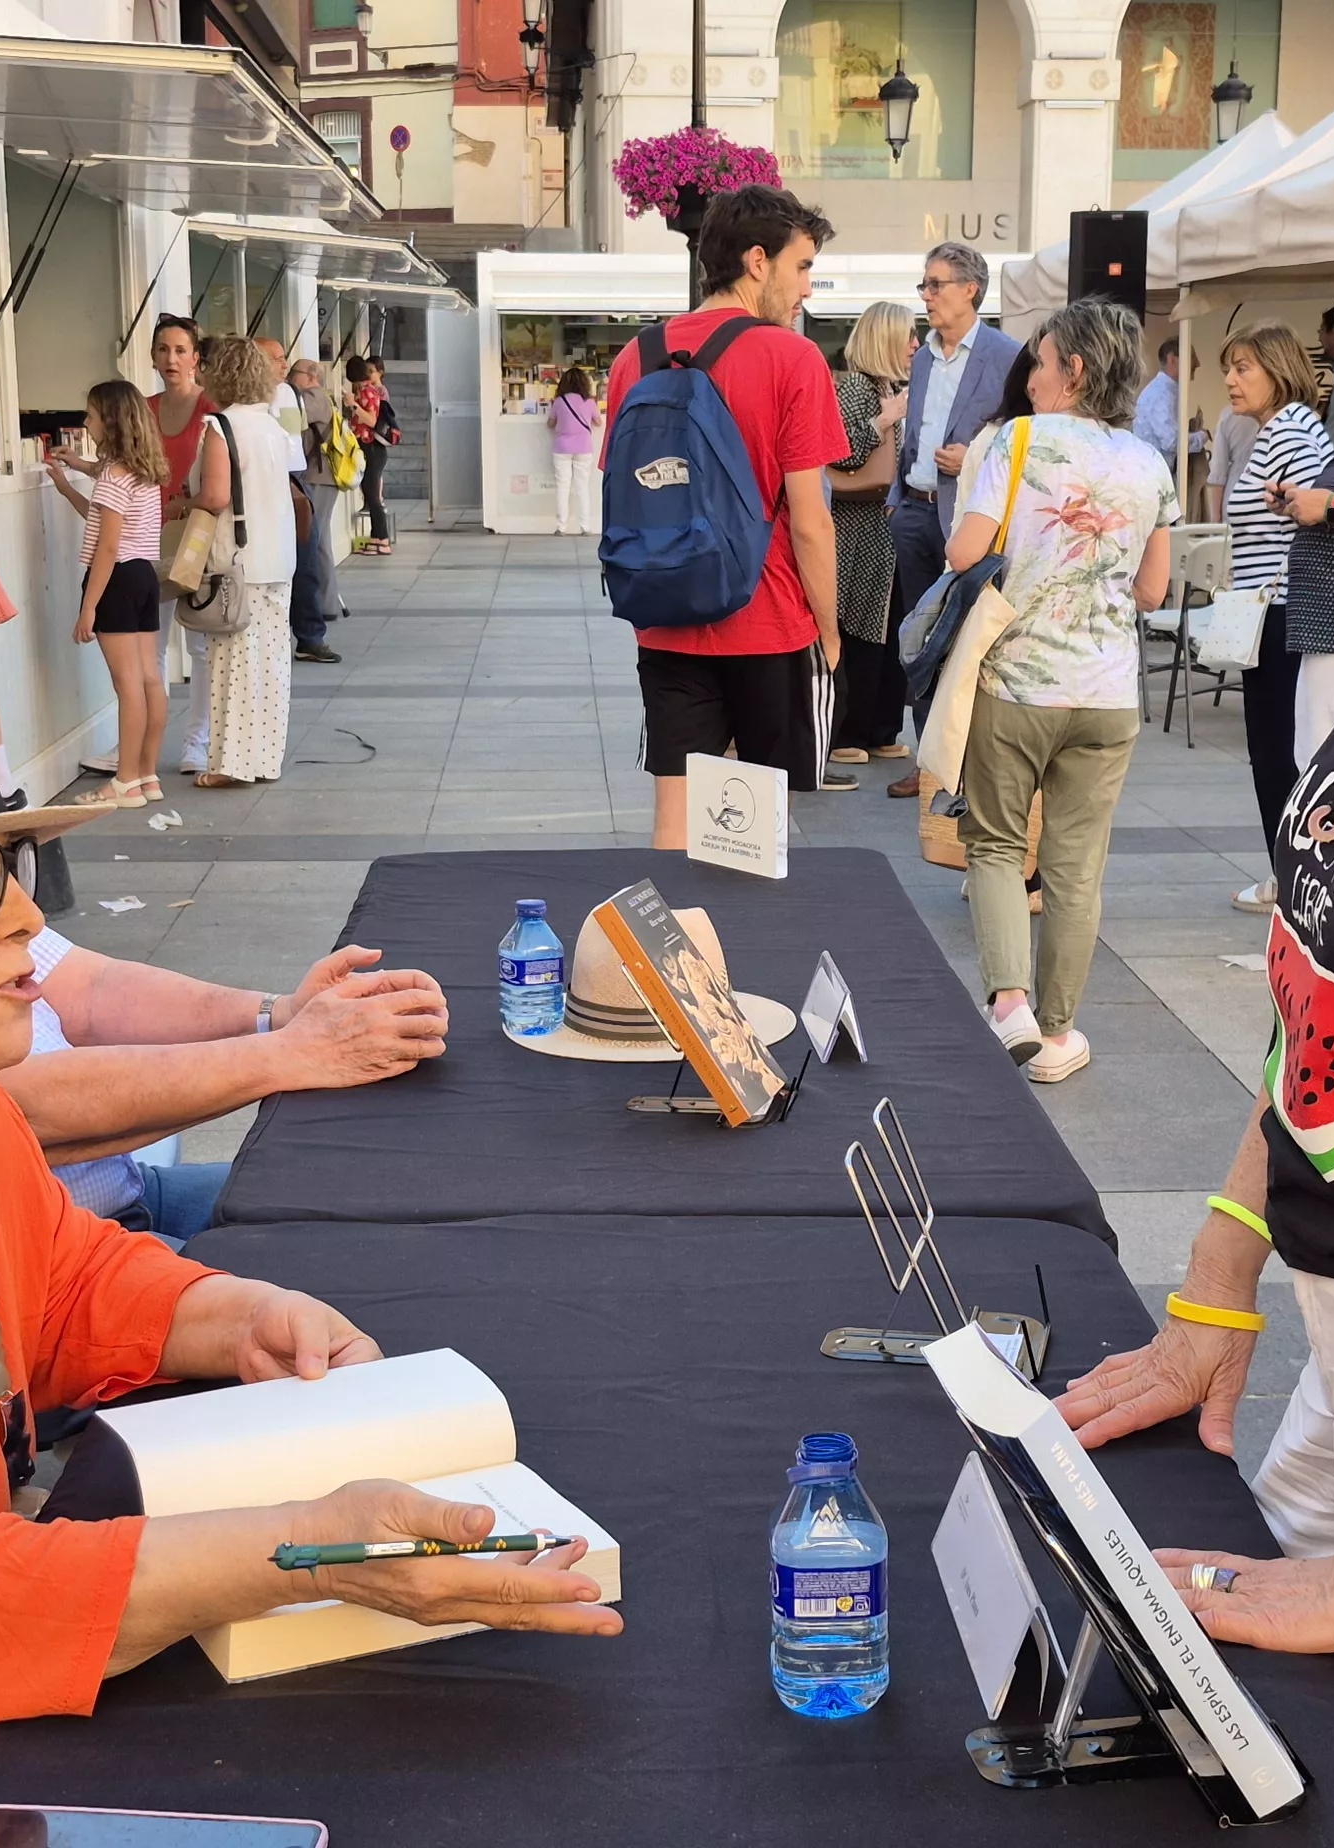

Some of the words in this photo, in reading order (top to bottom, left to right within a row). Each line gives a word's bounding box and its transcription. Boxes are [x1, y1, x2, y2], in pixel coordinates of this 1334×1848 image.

[1050, 1440, 1080, 1480] PLANA
[1104, 1528, 1147, 1588] AQUILES
[1144, 1587, 1183, 1646] ENIGMA
[1179, 1642, 1195, 1665] EL
[1188, 1662, 1201, 1677] Y
[1197, 1675, 1232, 1724] ESPÍAS
[1225, 1722, 1249, 1750] LAS
